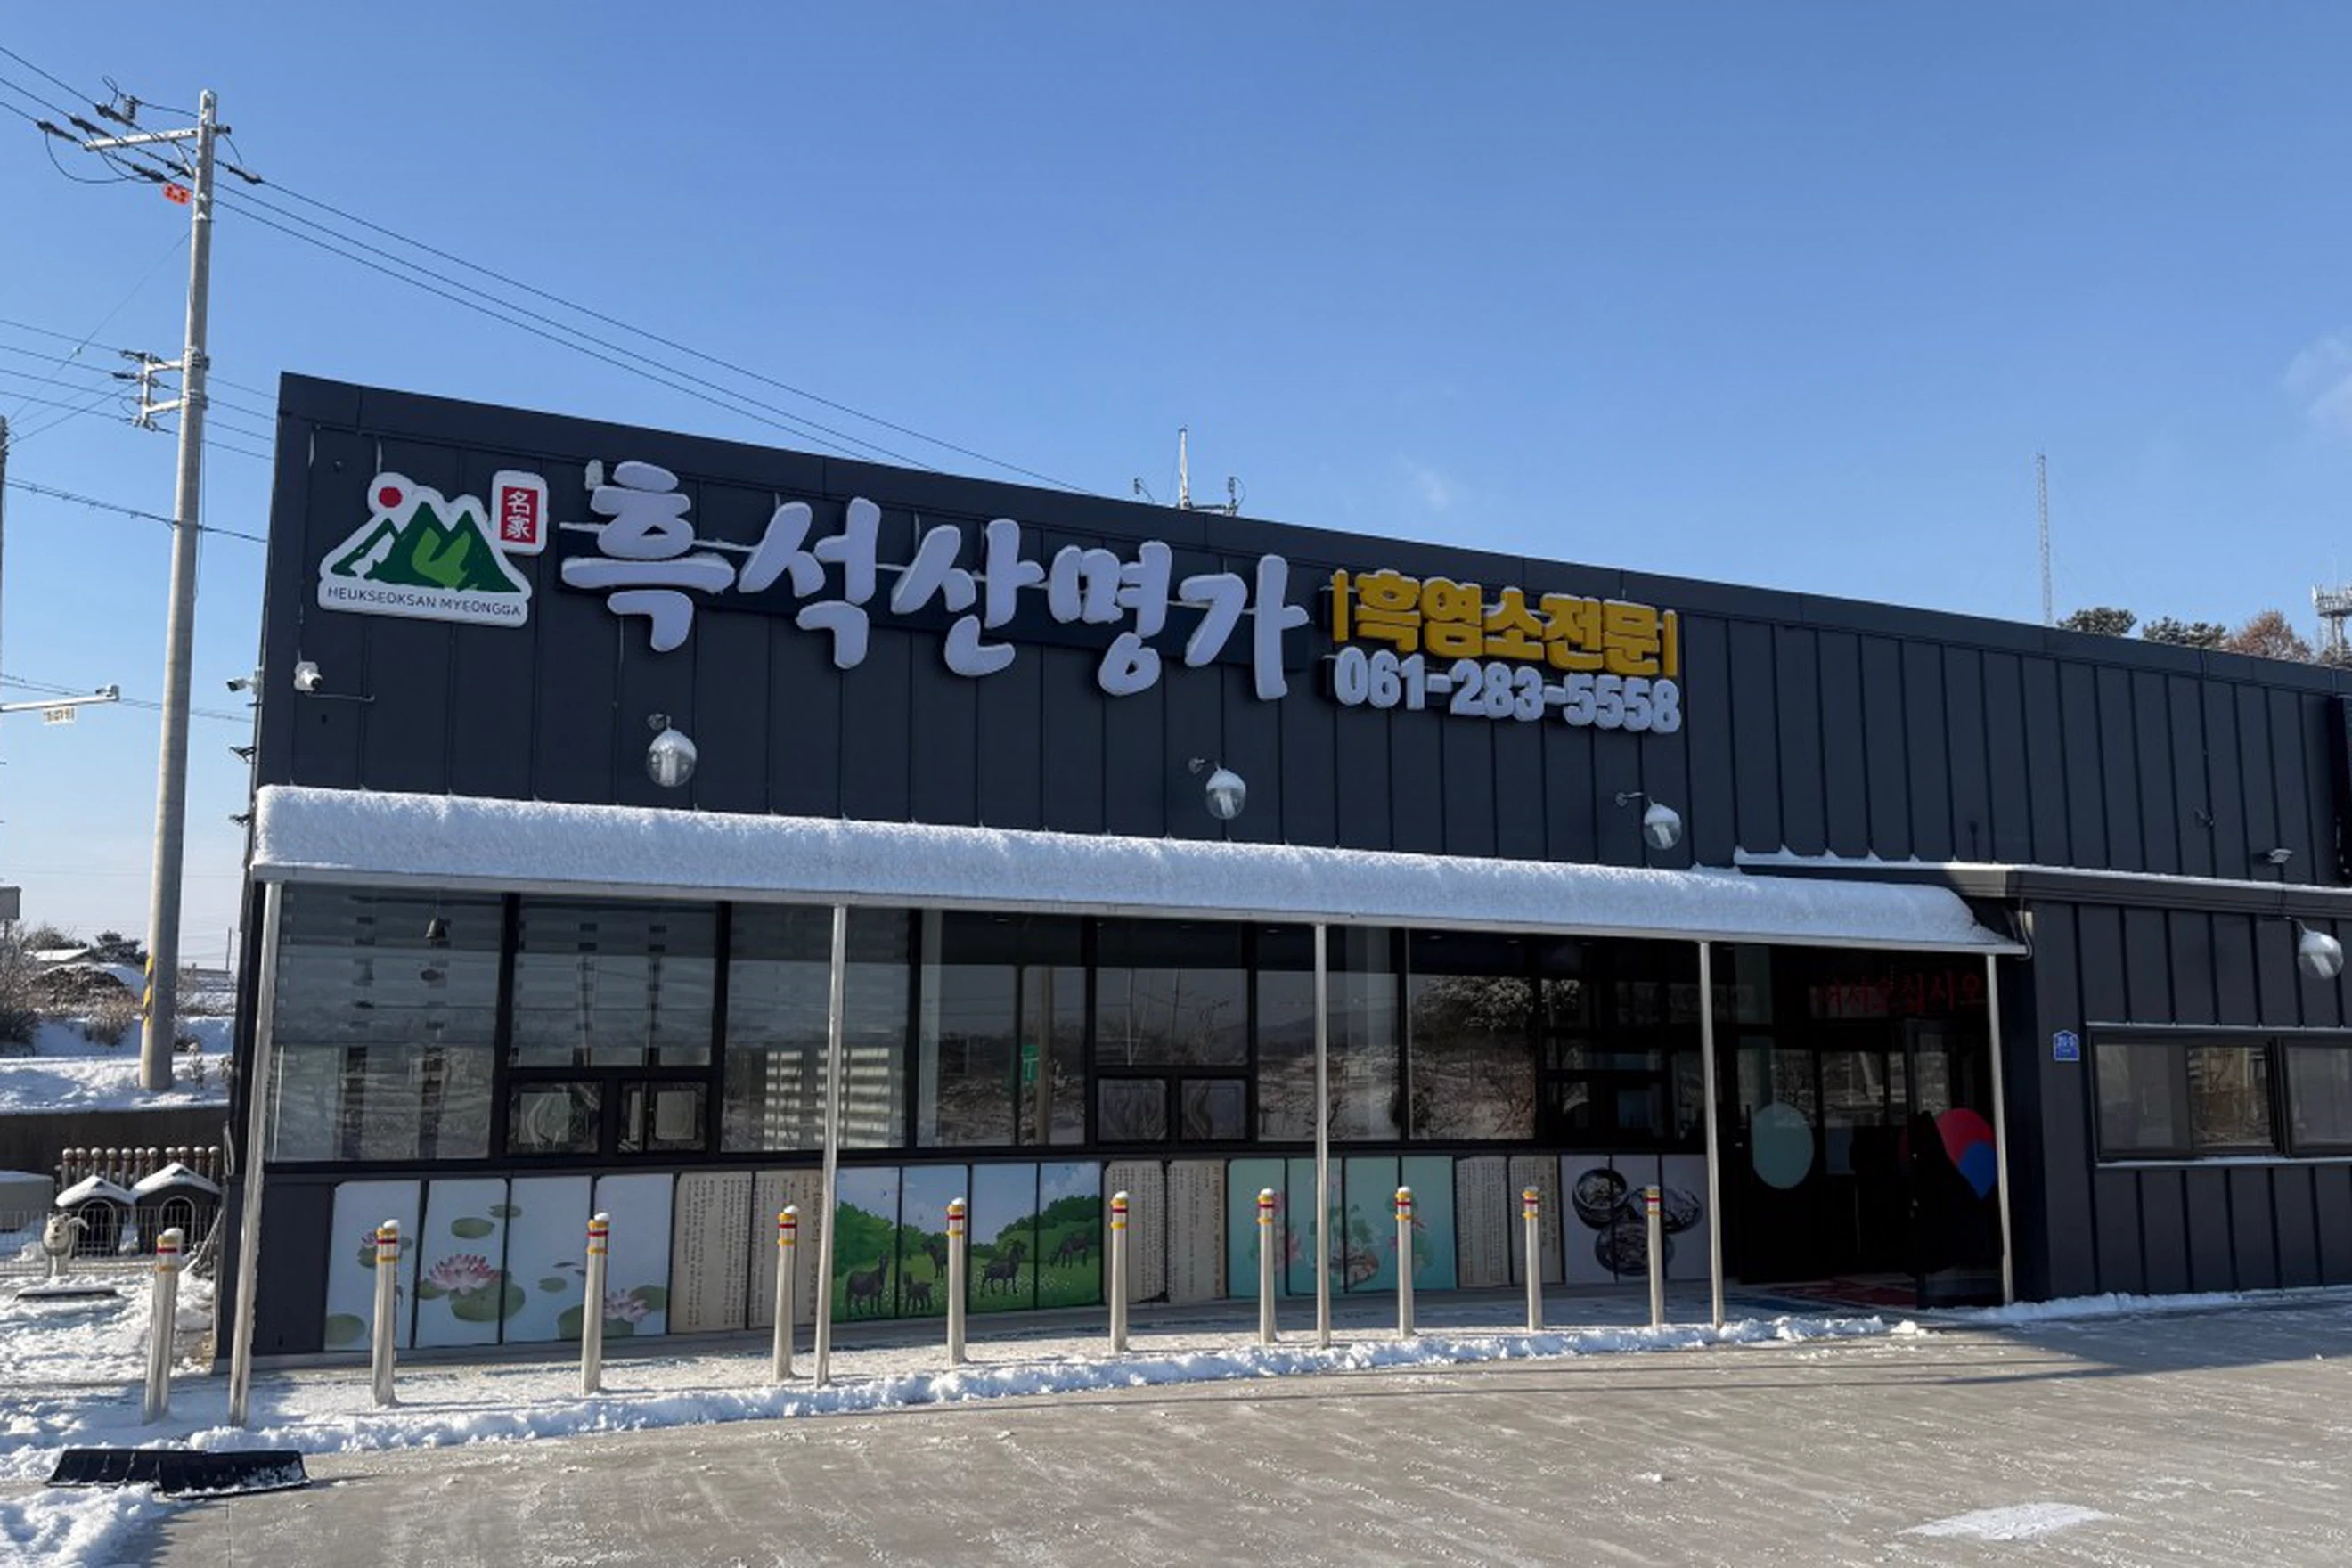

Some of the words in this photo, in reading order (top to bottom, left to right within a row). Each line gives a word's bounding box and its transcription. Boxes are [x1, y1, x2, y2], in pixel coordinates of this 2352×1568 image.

[506, 490, 531, 540] 名家
[327, 586, 437, 608] HEUKSEOKSAN
[439, 598, 522, 617] MYEONGGA
[560, 460, 1311, 701] 흑석산명가
[1334, 646, 1682, 734] 061-283-5558
